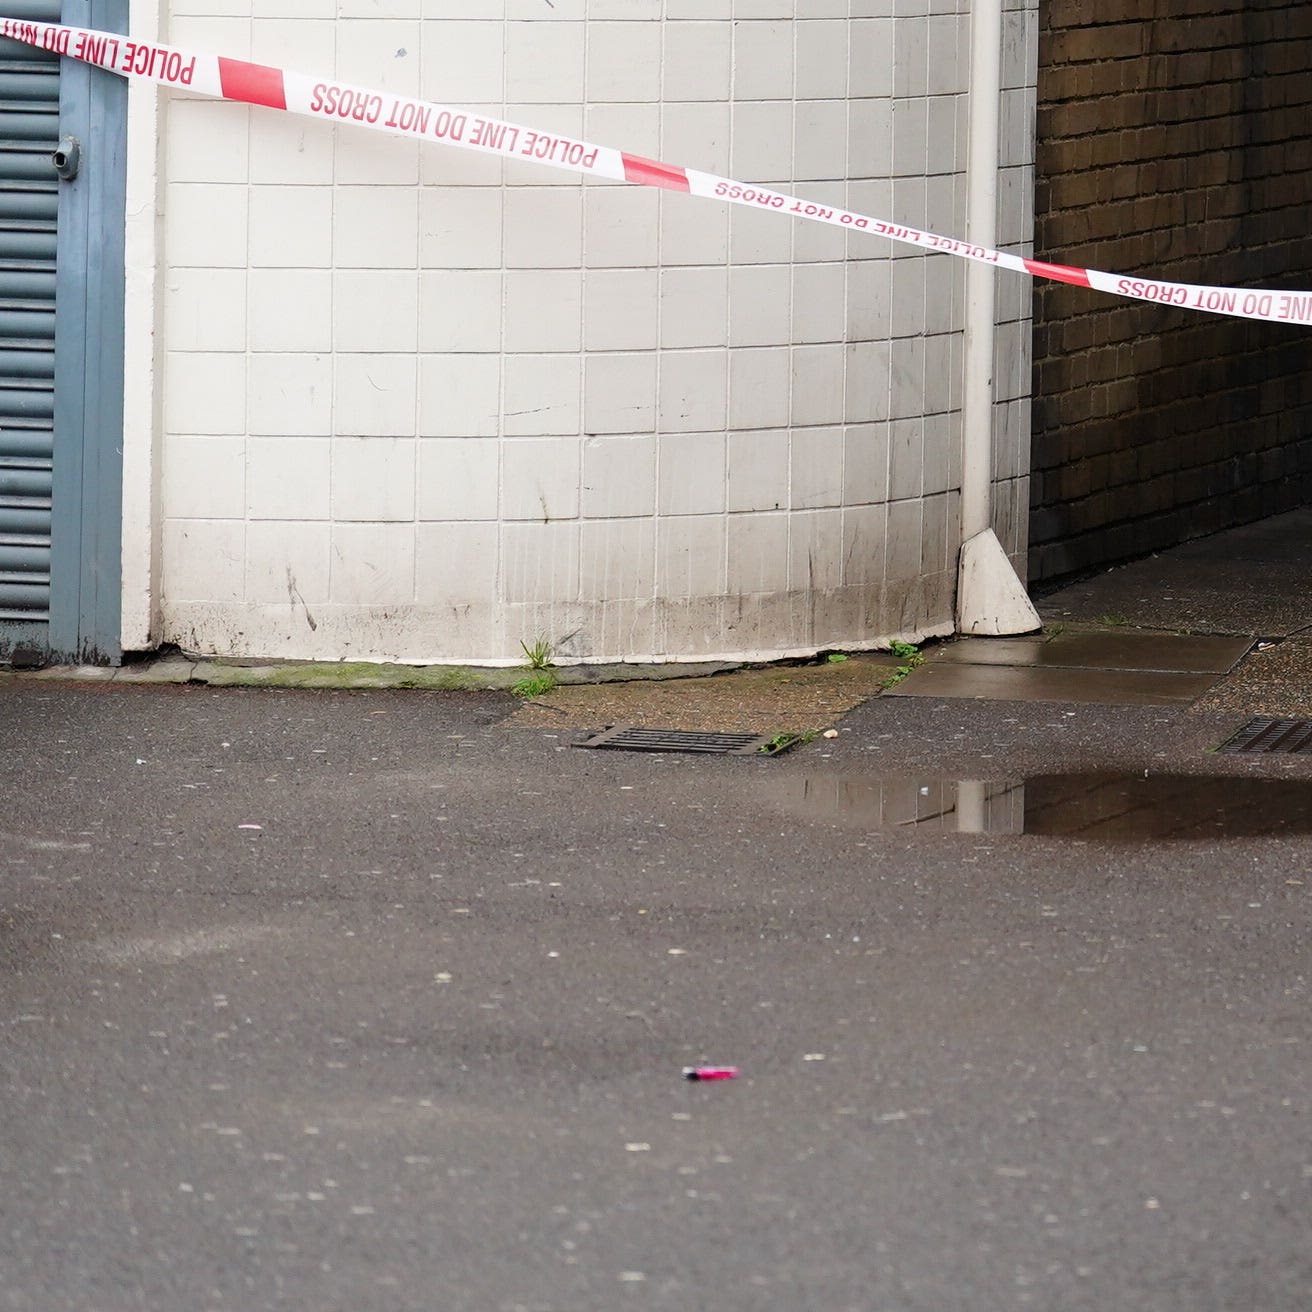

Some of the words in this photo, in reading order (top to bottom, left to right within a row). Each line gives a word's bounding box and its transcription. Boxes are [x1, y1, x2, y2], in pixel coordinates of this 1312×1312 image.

[43, 27, 71, 57] DO
[74, 32, 119, 69] LINE
[122, 41, 196, 86] POLICE
[310, 83, 383, 124] CROSS
[384, 100, 432, 134] NOT
[434, 111, 467, 140] DO
[469, 118, 520, 152] LINE
[521, 131, 599, 169] POLICE
[715, 182, 785, 208] CROSS
[790, 201, 833, 220] NOT
[840, 214, 868, 228] DO
[874, 223, 920, 239] LINE
[1117, 279, 1187, 305] CROSS
[1192, 289, 1237, 312] NOT
[1242, 293, 1273, 317] DO
